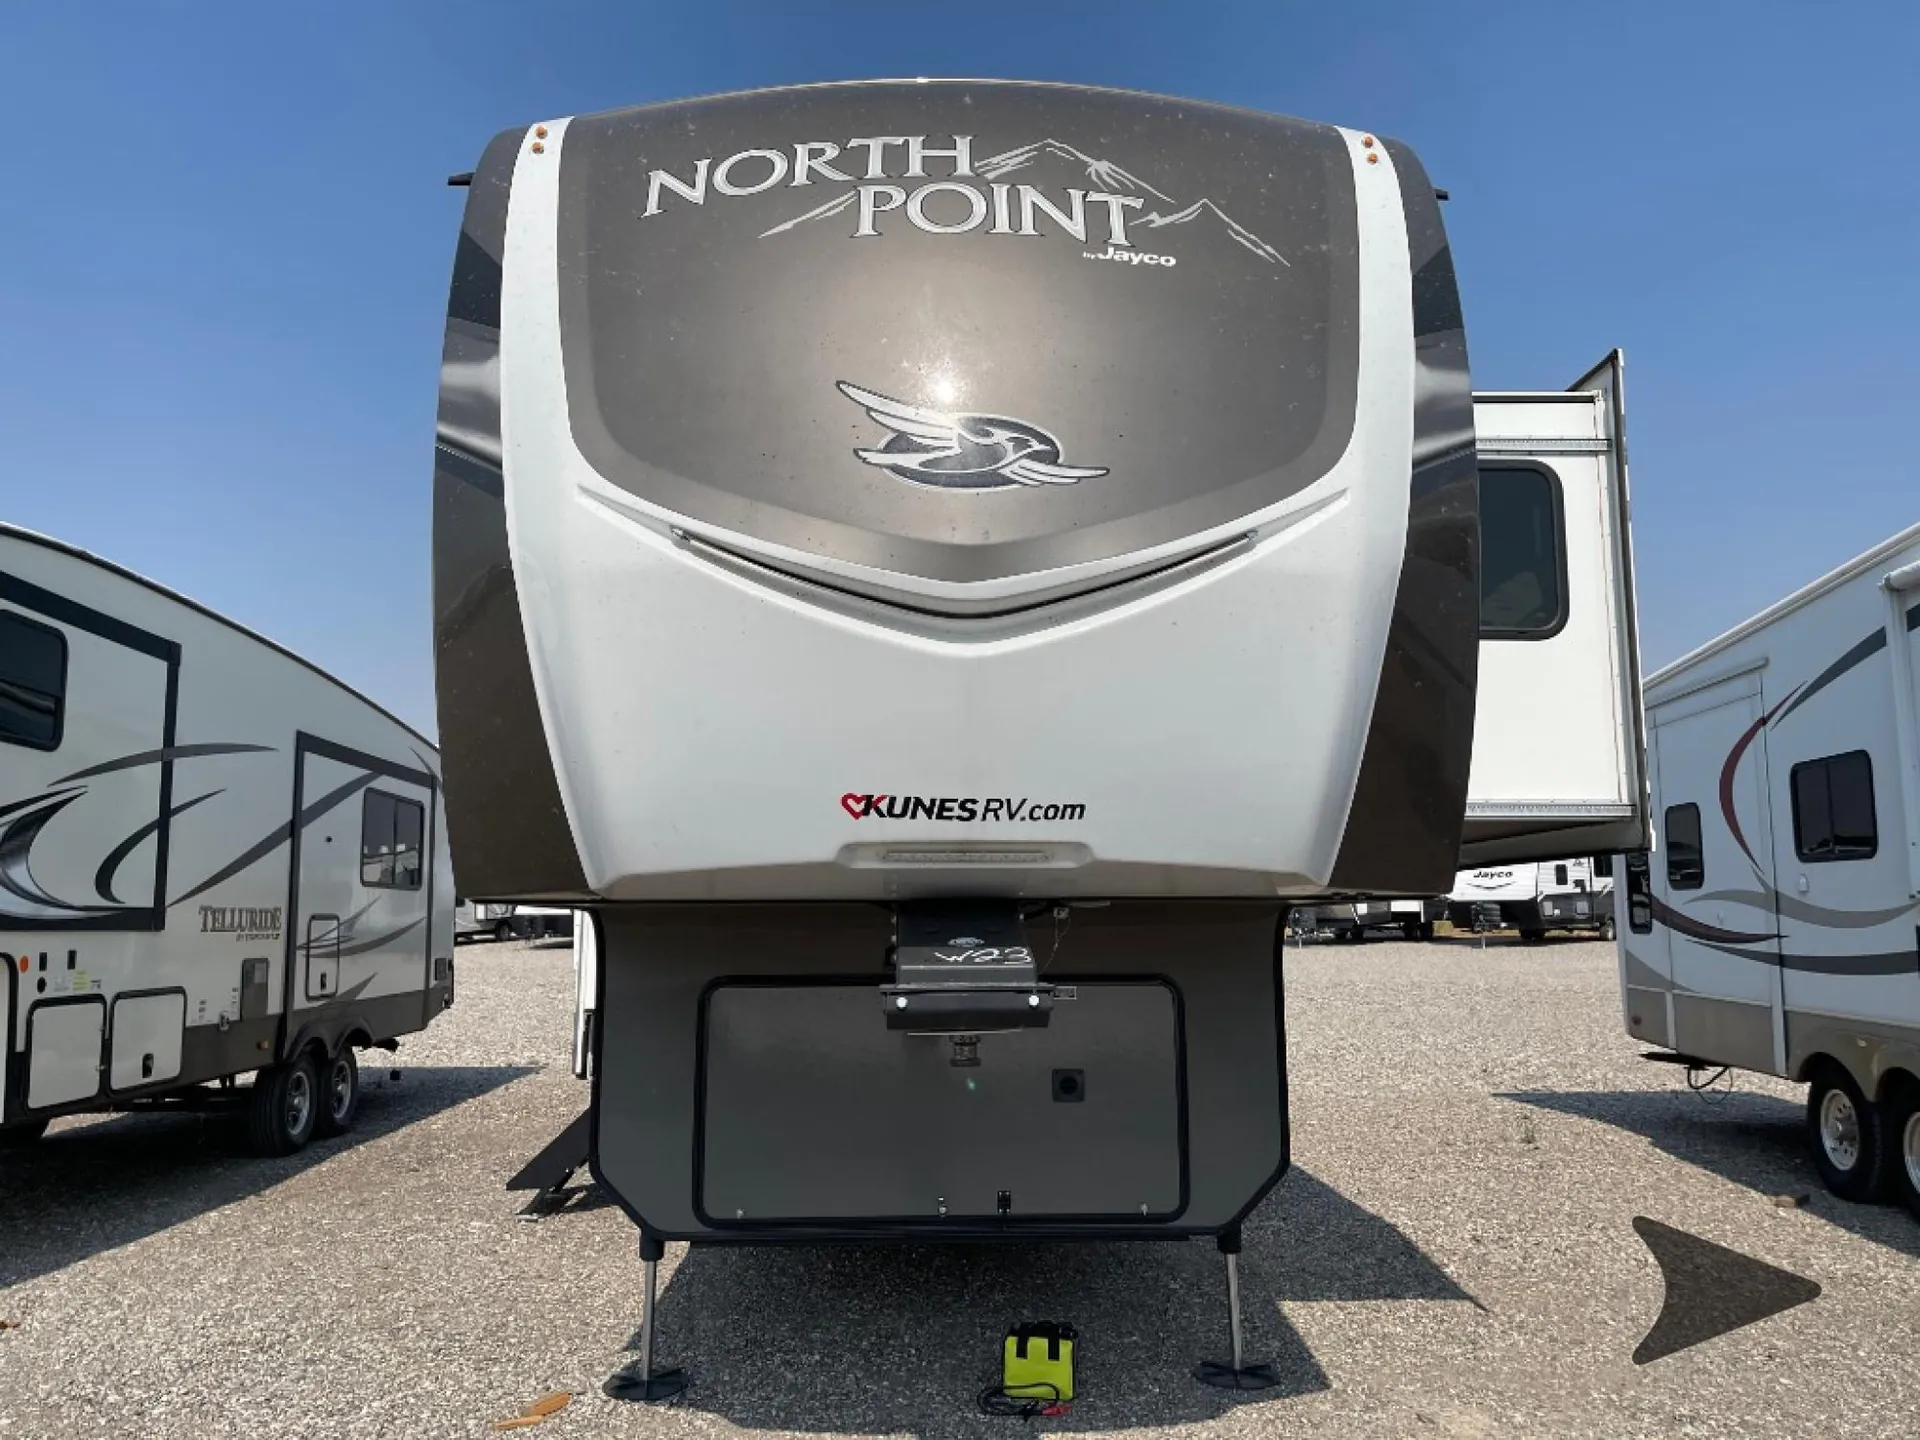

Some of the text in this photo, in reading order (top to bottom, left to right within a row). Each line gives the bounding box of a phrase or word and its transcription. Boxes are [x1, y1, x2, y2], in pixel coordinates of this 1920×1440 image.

[640, 134, 976, 218] NORTH
[850, 181, 1144, 247] POINT
[1097, 245, 1177, 267] Jayco
[1473, 871, 1514, 879] Jayco
[199, 904, 282, 933] TELLURIDE
